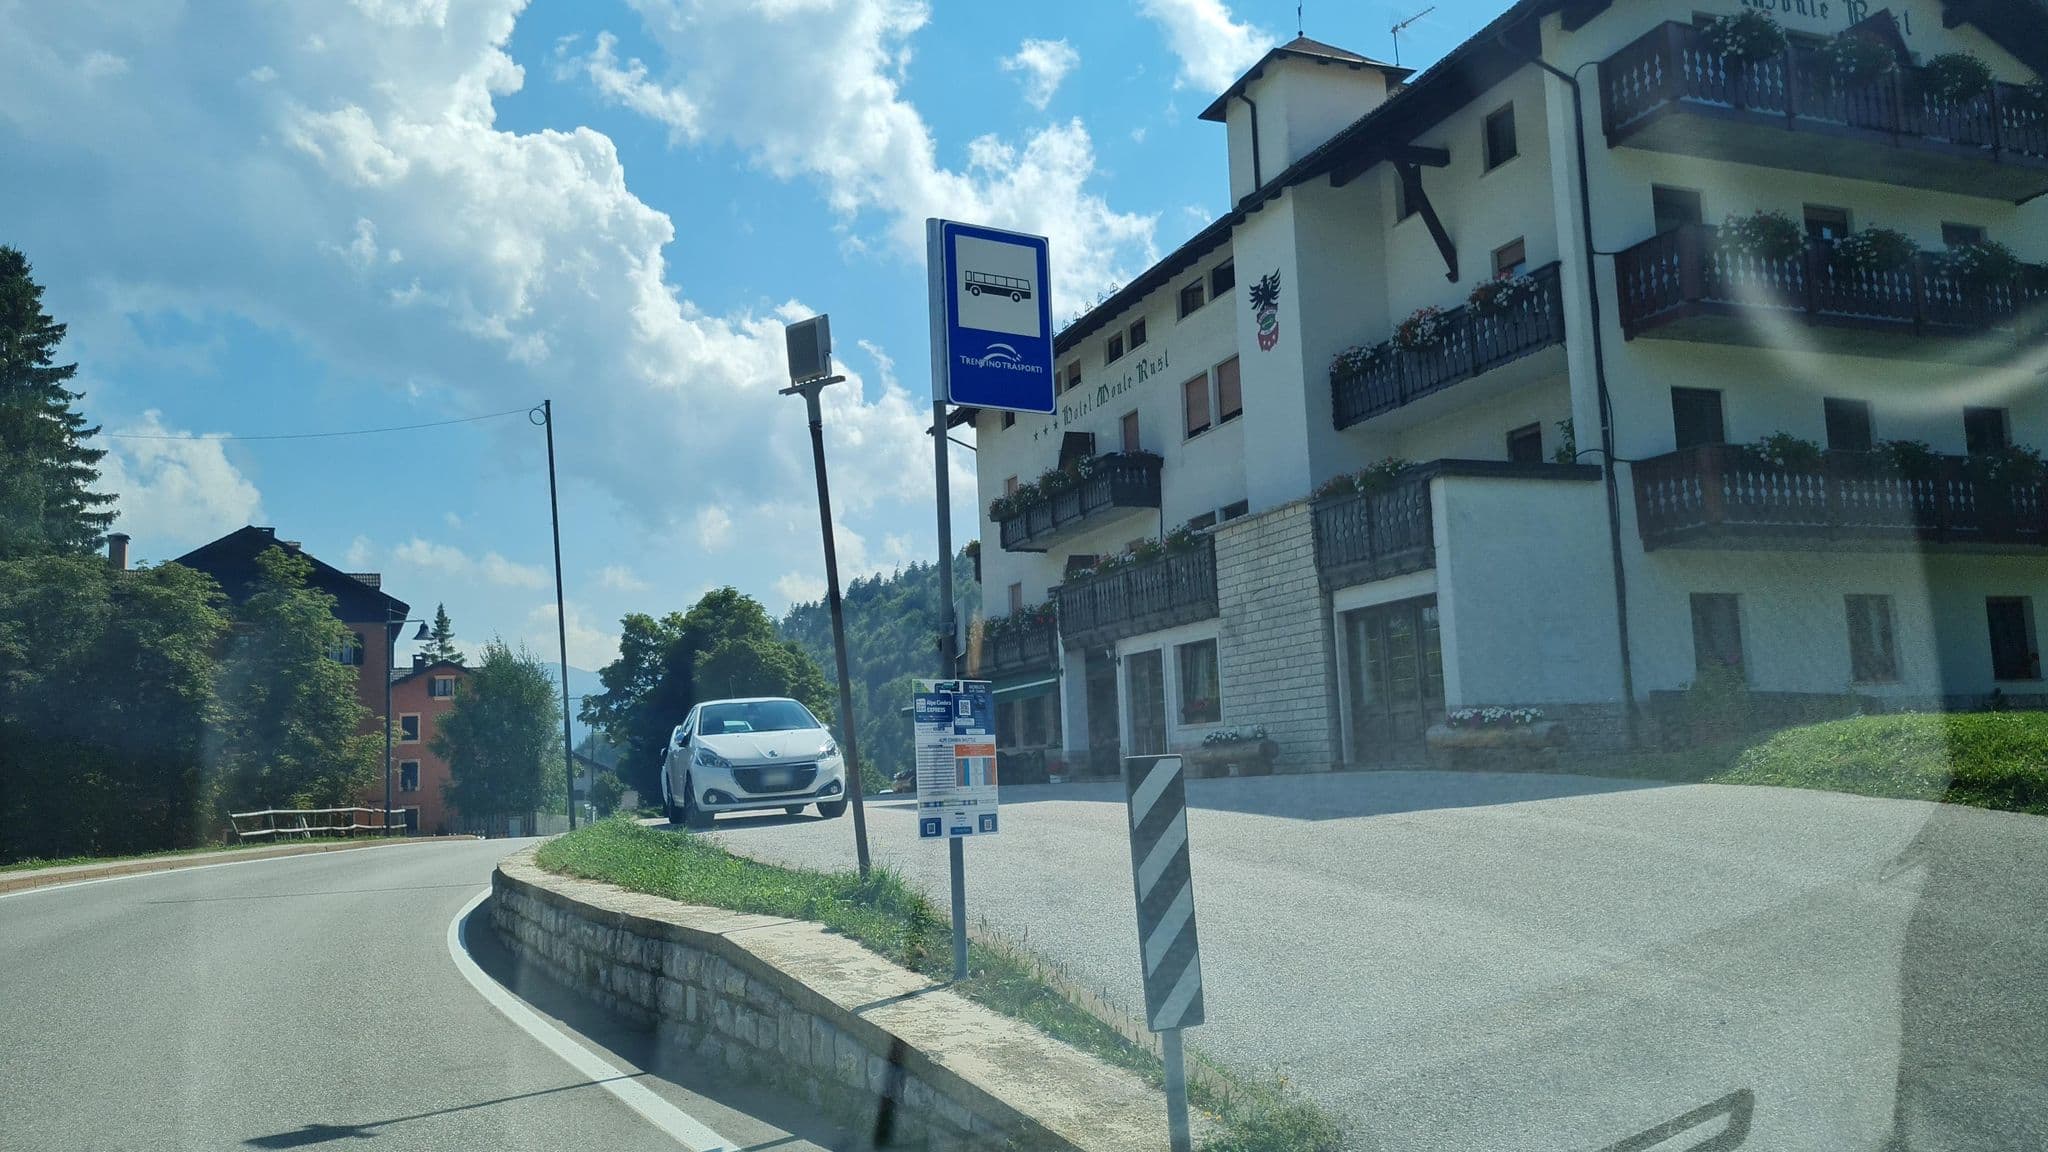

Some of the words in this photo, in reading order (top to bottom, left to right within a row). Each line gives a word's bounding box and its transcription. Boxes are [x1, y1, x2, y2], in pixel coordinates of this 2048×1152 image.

[960, 355, 1001, 369] TRENTINO
[1003, 362, 1043, 374] TRASPORTI
[1062, 393, 1092, 426] Hotel
[1097, 373, 1132, 408] Monte
